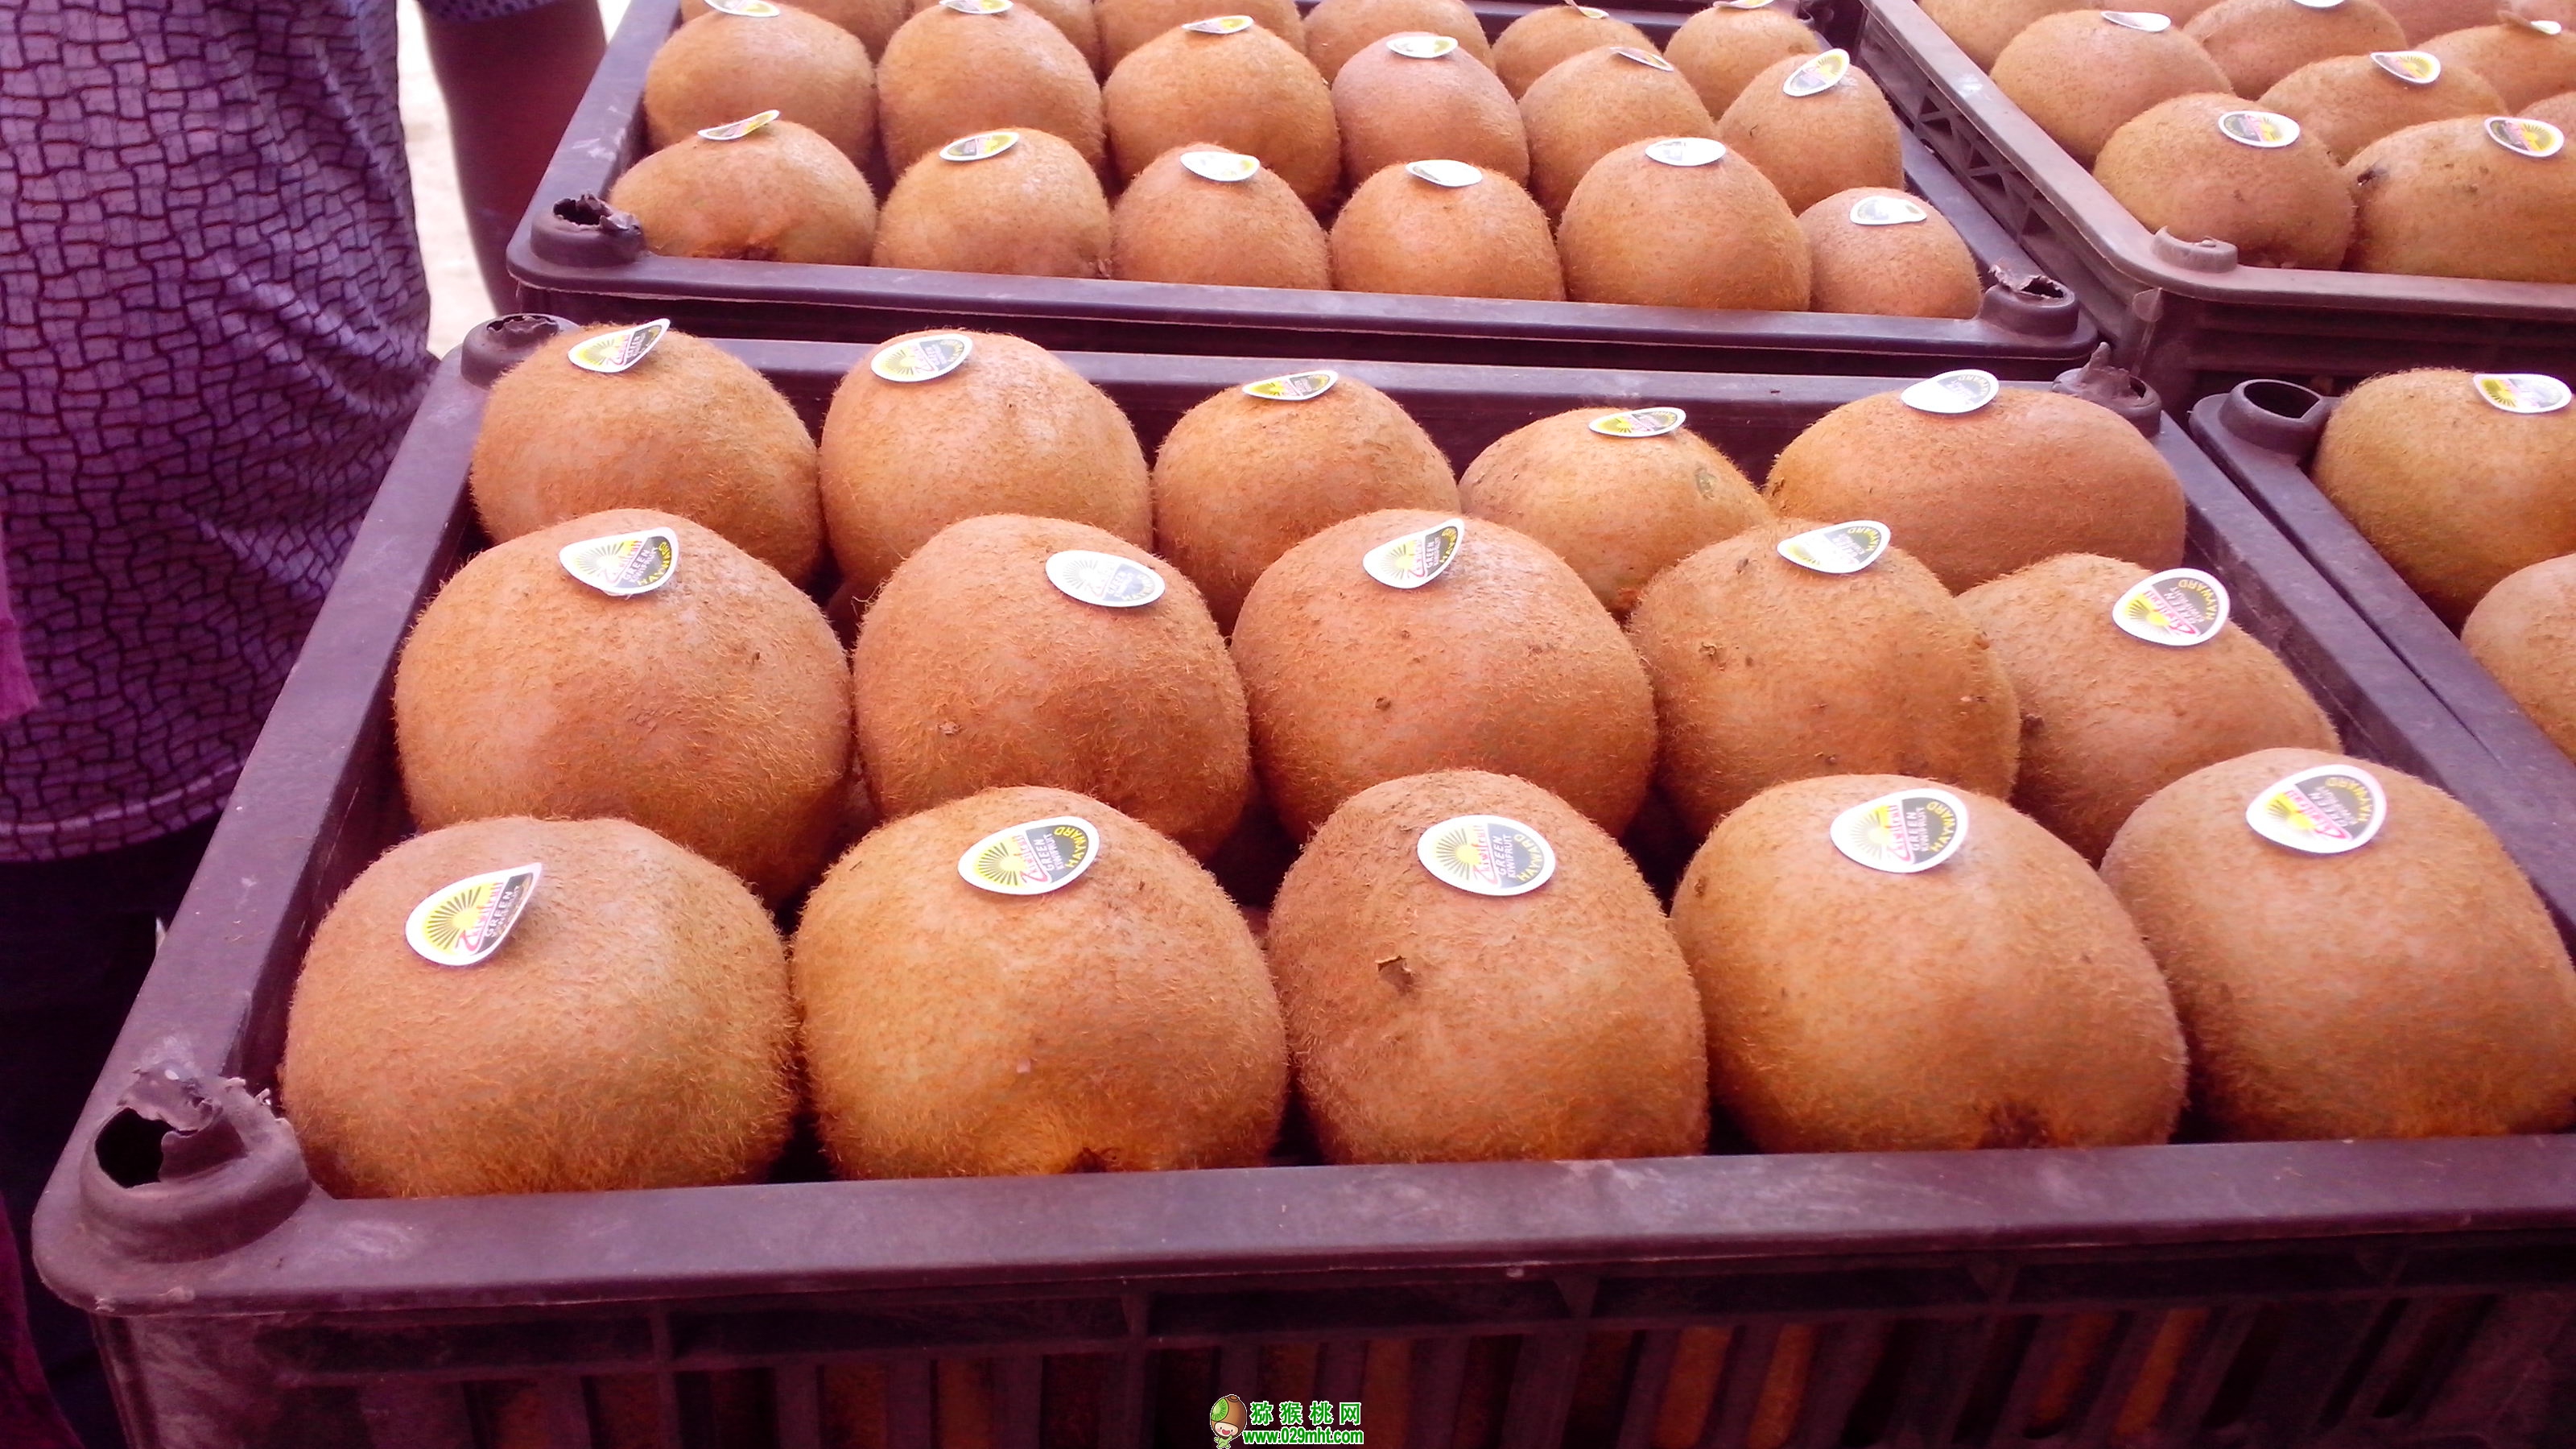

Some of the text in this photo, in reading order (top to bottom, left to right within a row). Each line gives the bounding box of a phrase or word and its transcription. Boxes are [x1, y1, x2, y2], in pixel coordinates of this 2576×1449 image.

[623, 549, 650, 580] GREEN
[637, 541, 671, 586] HAYWARD
[2163, 592, 2196, 625] GREEN
[2178, 579, 2218, 621] HAYWARD
[2324, 776, 2372, 822] HAYWARD
[1054, 825, 1088, 868] HAYWARD
[1905, 811, 1921, 852] GREEN
[1926, 801, 1956, 852] HAYWARD
[1033, 838, 1055, 872] GREEN
[1042, 833, 1065, 871] KIWIFRUIT
[1492, 835, 1507, 876] GREEN
[1502, 833, 1517, 878] KIWIFRUIT
[1513, 833, 1543, 882] HAYWARD
[484, 890, 514, 938] GREEN
